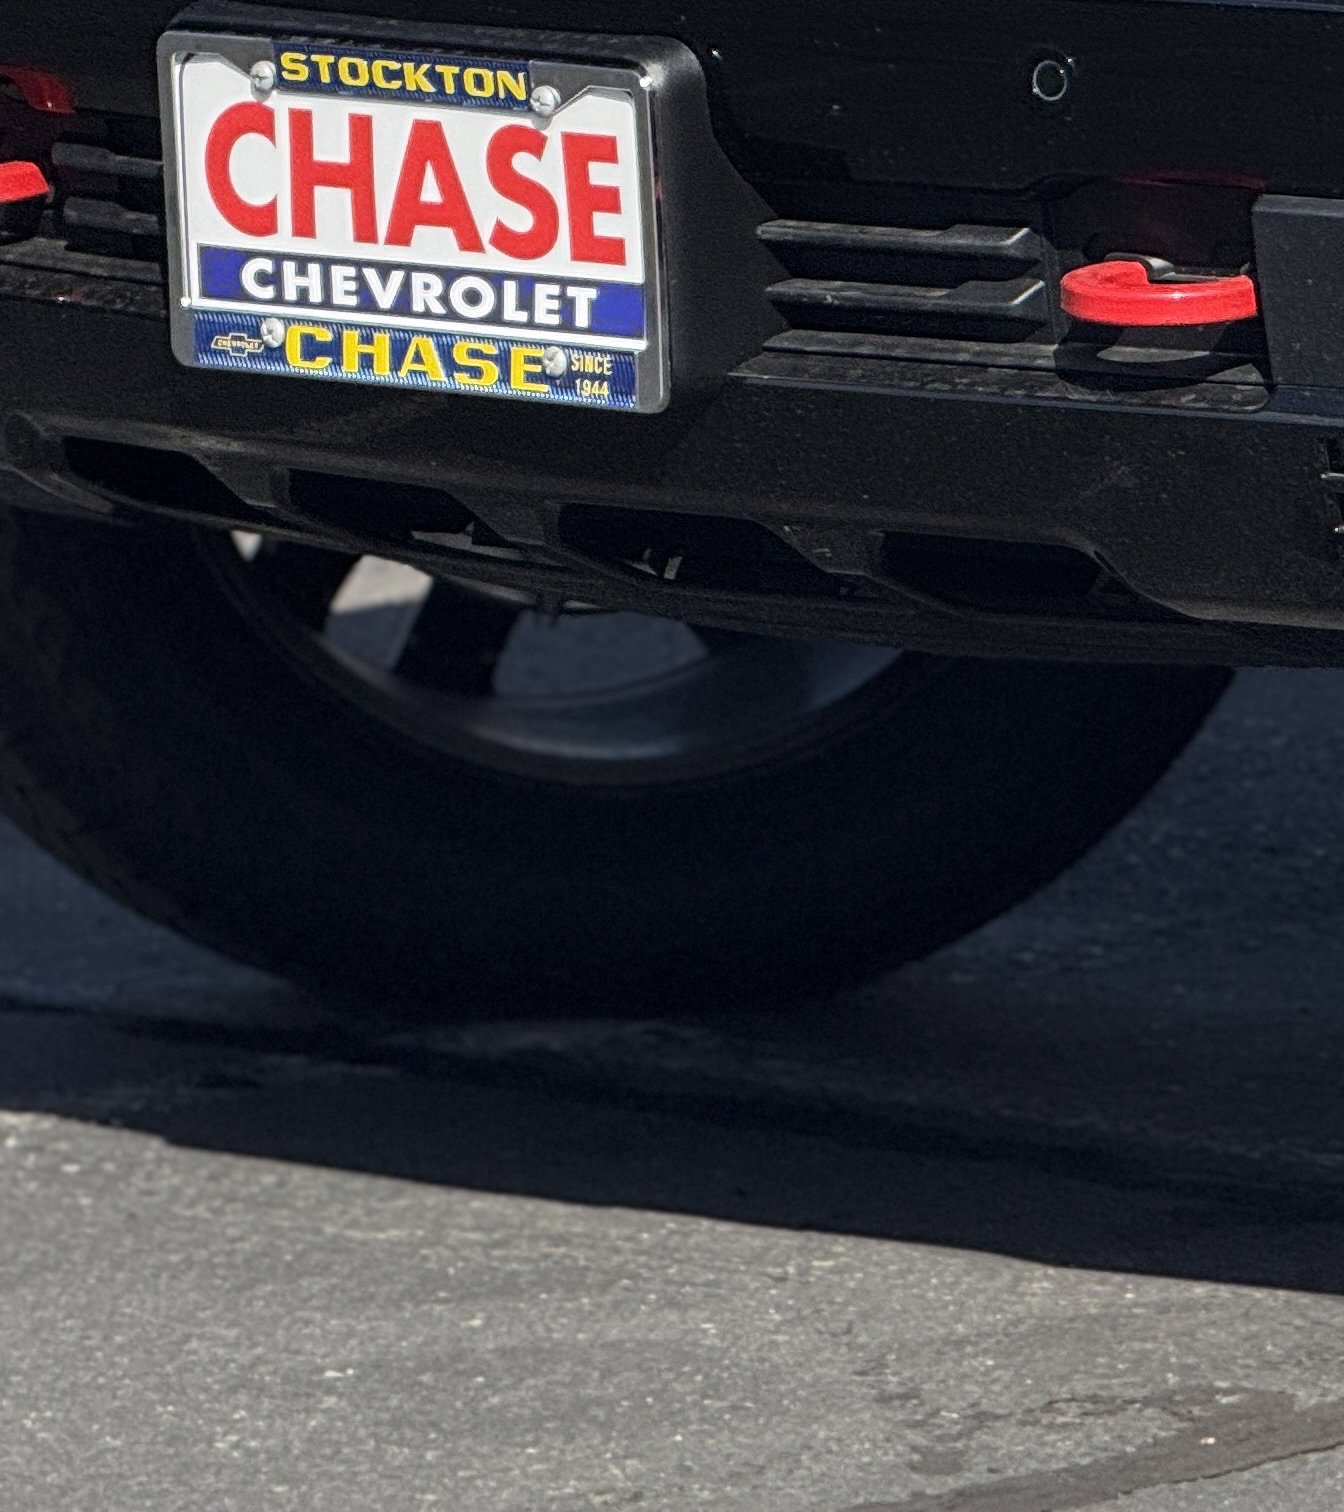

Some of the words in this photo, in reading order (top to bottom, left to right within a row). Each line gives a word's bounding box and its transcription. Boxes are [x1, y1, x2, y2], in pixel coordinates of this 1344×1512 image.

[279, 51, 528, 102] STOCKTON
[204, 100, 628, 267] CHASE
[239, 257, 600, 329] CHEVROLET
[285, 324, 552, 394] CHASE
[570, 352, 614, 376] SINCE
[575, 377, 610, 398] 1944
